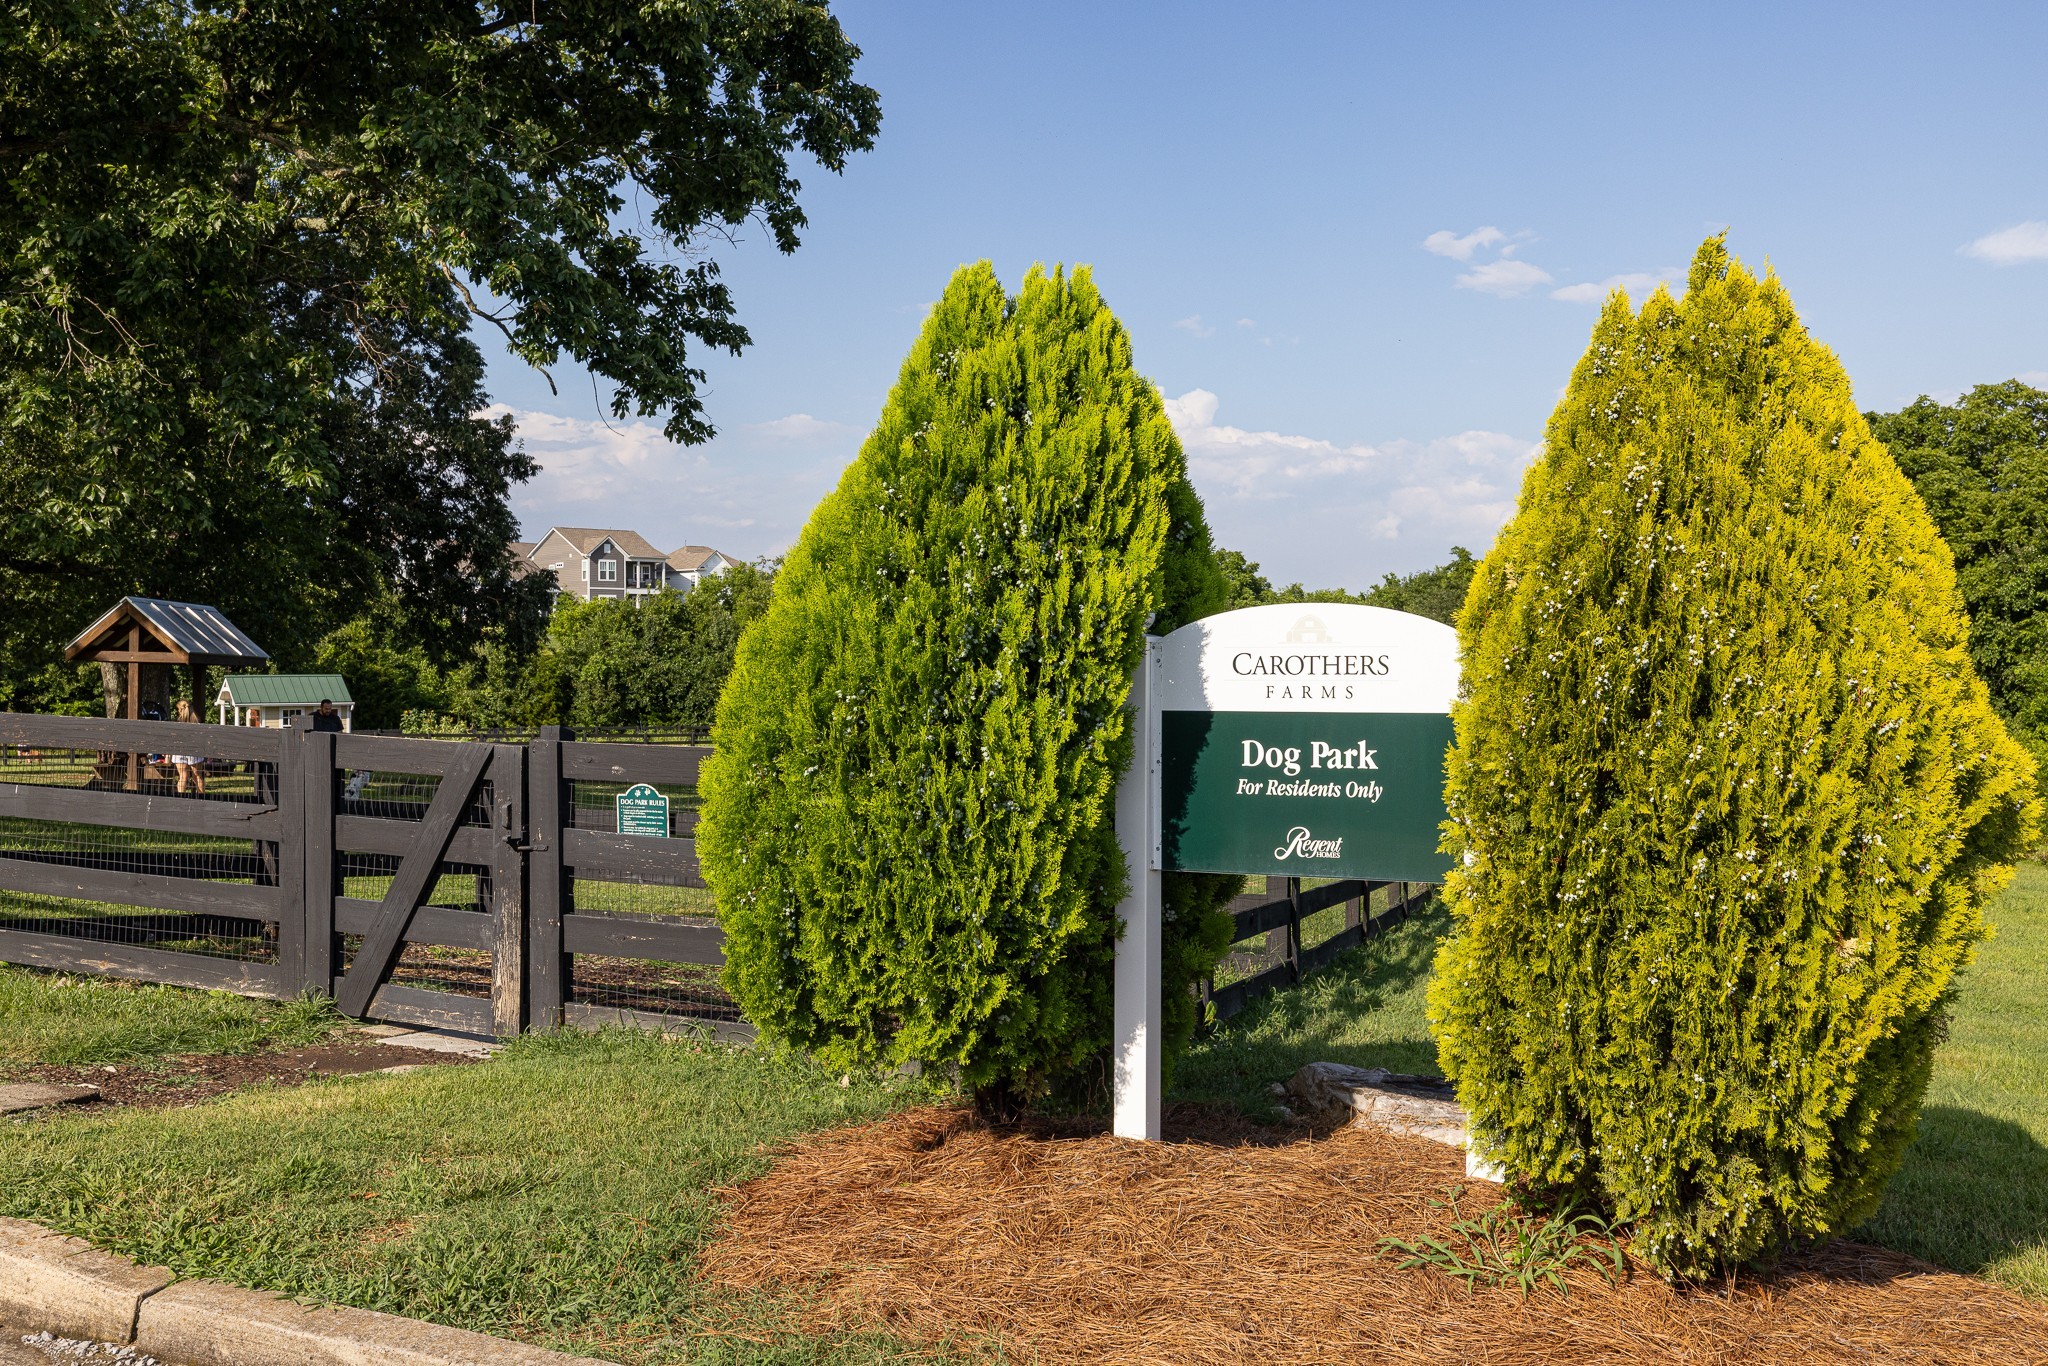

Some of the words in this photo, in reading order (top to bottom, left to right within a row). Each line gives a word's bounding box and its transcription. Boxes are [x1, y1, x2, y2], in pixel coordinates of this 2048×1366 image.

[1232, 652, 1389, 676] CAROTHERS
[1266, 685, 1354, 699] FARMS
[1241, 739, 1301, 776] Dog
[1310, 739, 1379, 770] Park
[1236, 778, 1263, 795] For
[1265, 778, 1341, 798] Residents
[1346, 781, 1383, 803] Only
[1274, 826, 1343, 860] Regent
[1316, 851, 1341, 859] HOMES
